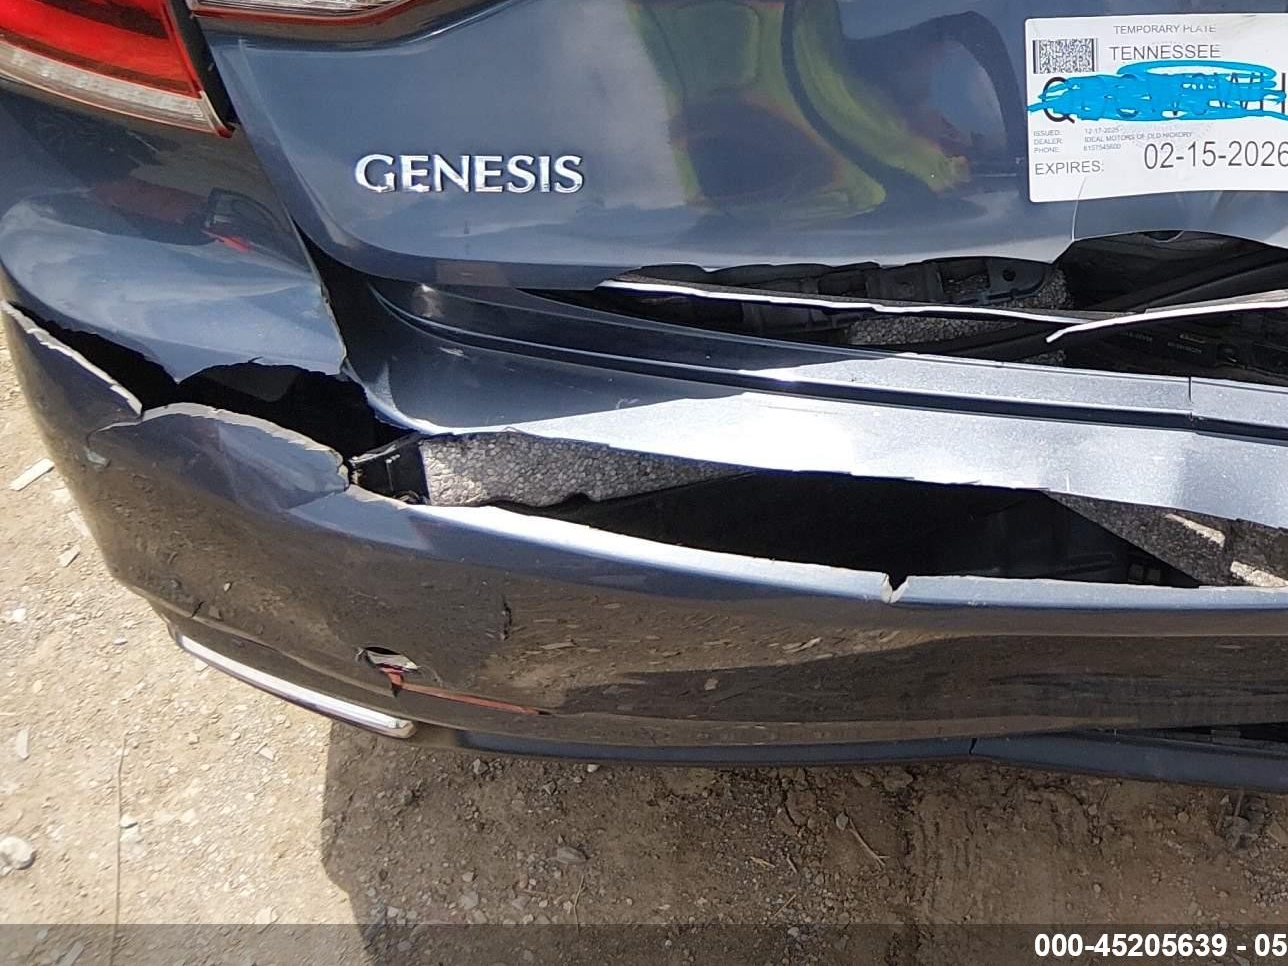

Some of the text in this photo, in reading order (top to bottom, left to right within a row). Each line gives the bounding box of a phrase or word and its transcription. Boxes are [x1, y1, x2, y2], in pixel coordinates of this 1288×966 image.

[1113, 24, 1216, 35] TEMPORARY PLATE
[1109, 44, 1222, 61] TENNESSEE
[355, 153, 585, 194] GENESIS
[1034, 160, 1105, 176] EXPIRES:
